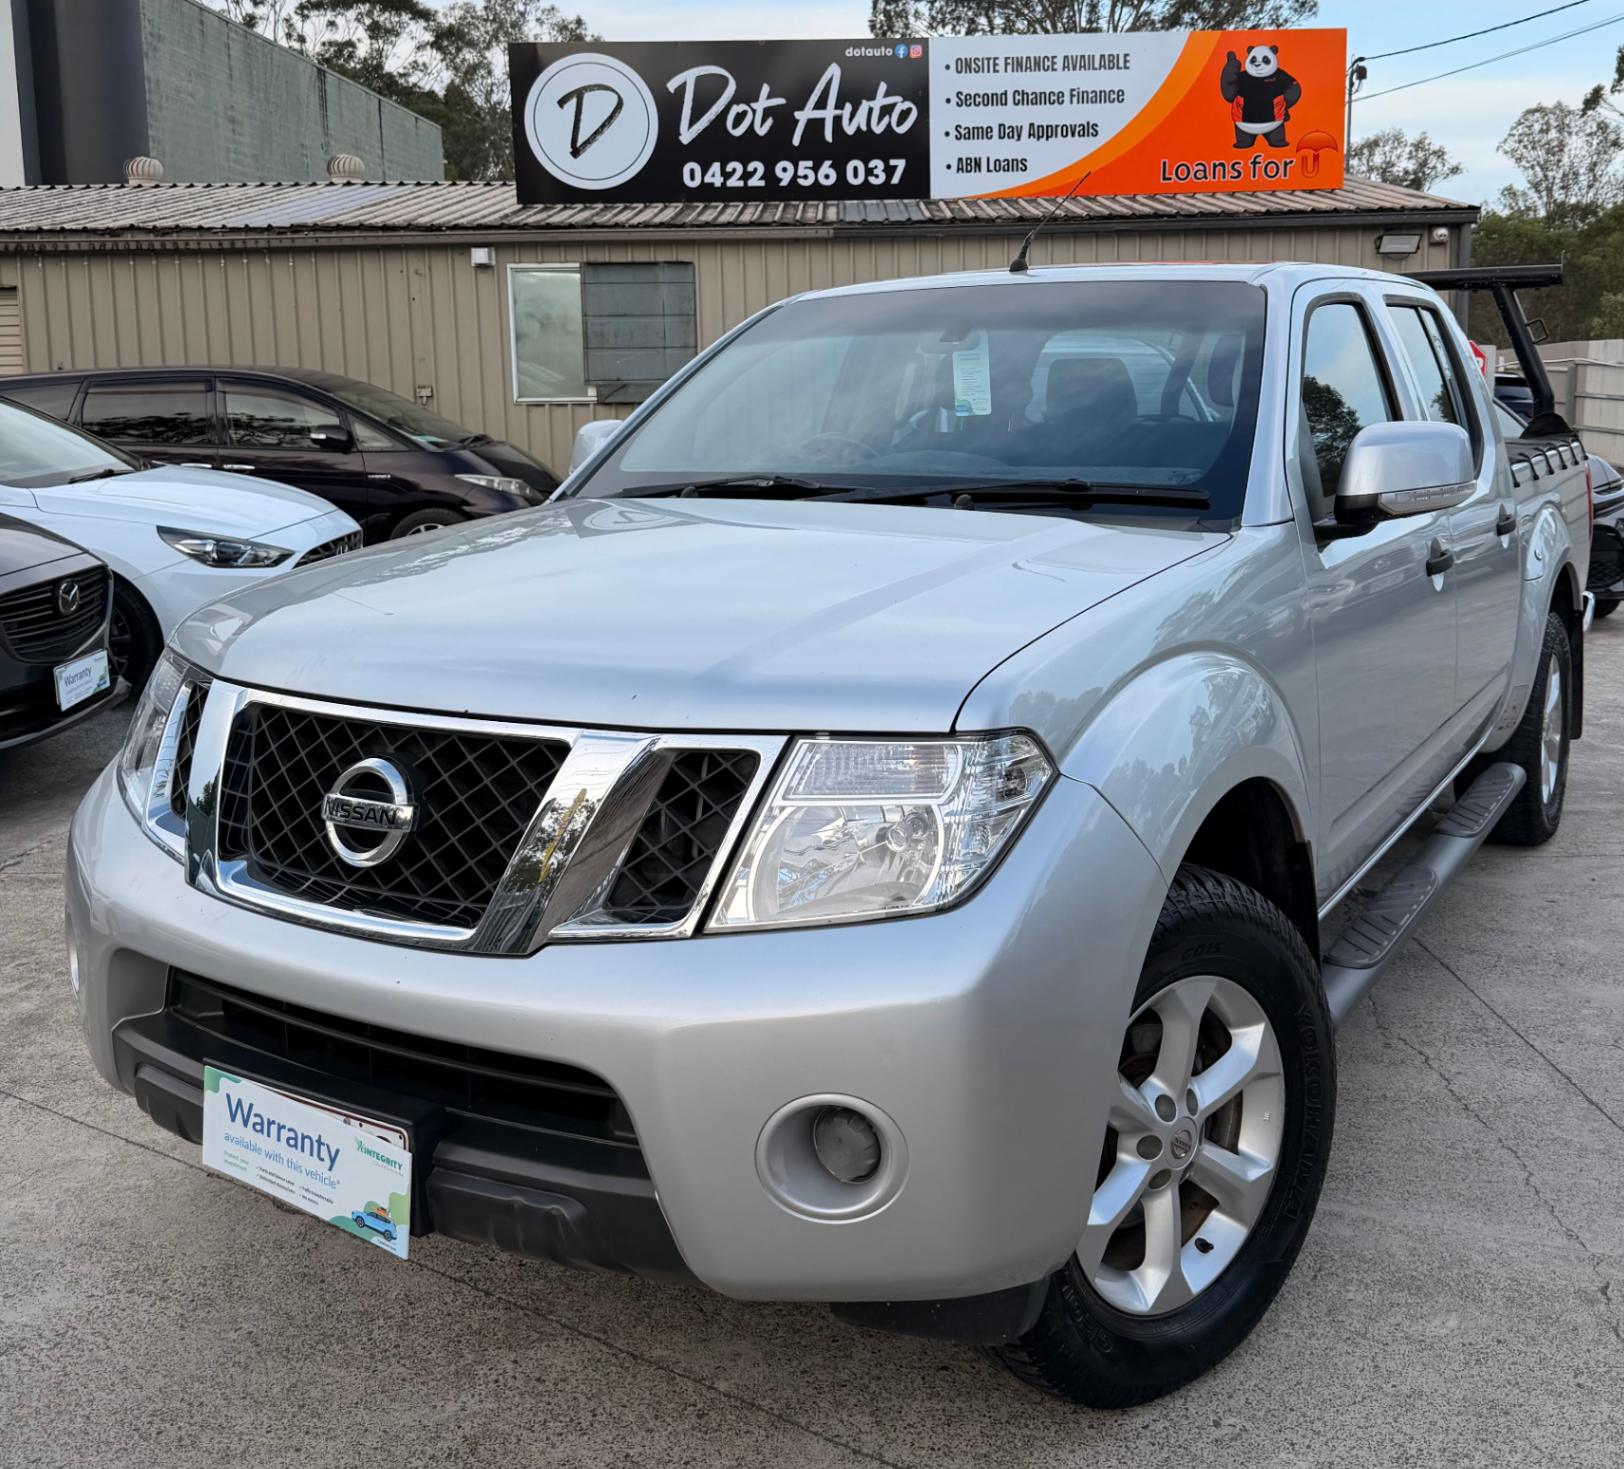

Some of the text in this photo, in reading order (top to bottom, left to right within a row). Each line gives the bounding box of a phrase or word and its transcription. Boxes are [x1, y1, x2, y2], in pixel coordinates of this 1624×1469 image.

[845, 45, 893, 58] dotauto
[955, 52, 1131, 75] ONSITE FINANCE AVAILABLE
[665, 61, 919, 148] Dot Auto
[955, 86, 1125, 108] Second Chance Finance
[556, 83, 624, 160] D
[954, 121, 1099, 142] Same Day Approvals
[682, 158, 907, 188] 0422 956 037
[955, 155, 1029, 175] ABN Loans
[1160, 158, 1244, 183] Loans
[1249, 154, 1295, 180] for
[64, 666, 93, 687] Warranty
[325, 795, 399, 826] NISSAN
[225, 1092, 341, 1172] Warranty
[223, 1131, 263, 1156] available
[264, 1148, 285, 1168] with
[286, 1156, 304, 1175] this
